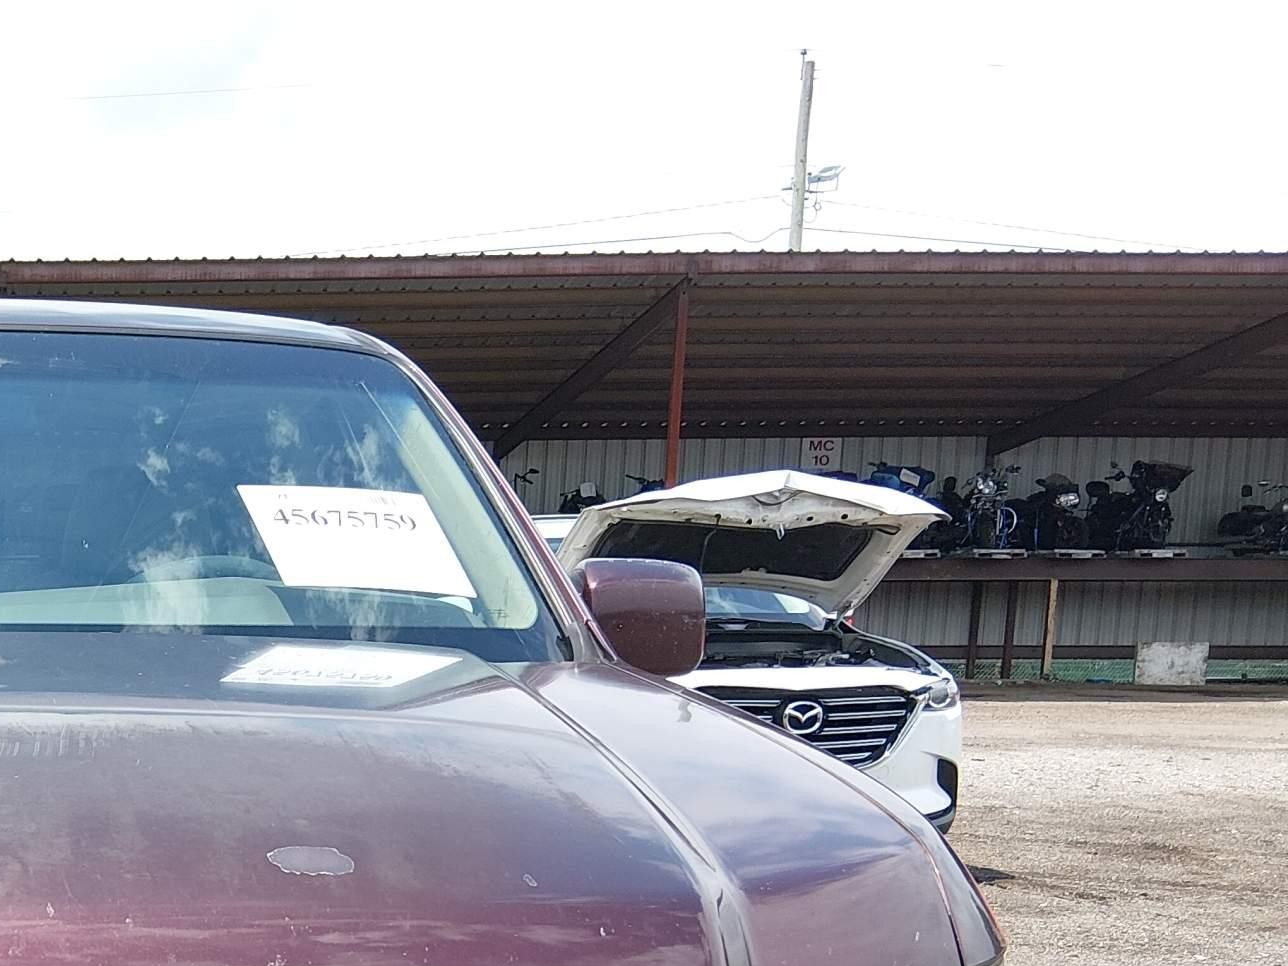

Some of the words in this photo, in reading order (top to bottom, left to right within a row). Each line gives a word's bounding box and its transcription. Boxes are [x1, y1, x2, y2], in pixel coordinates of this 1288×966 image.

[808, 439, 835, 452] MC
[811, 454, 830, 466] 10
[273, 508, 417, 531] 45675759
